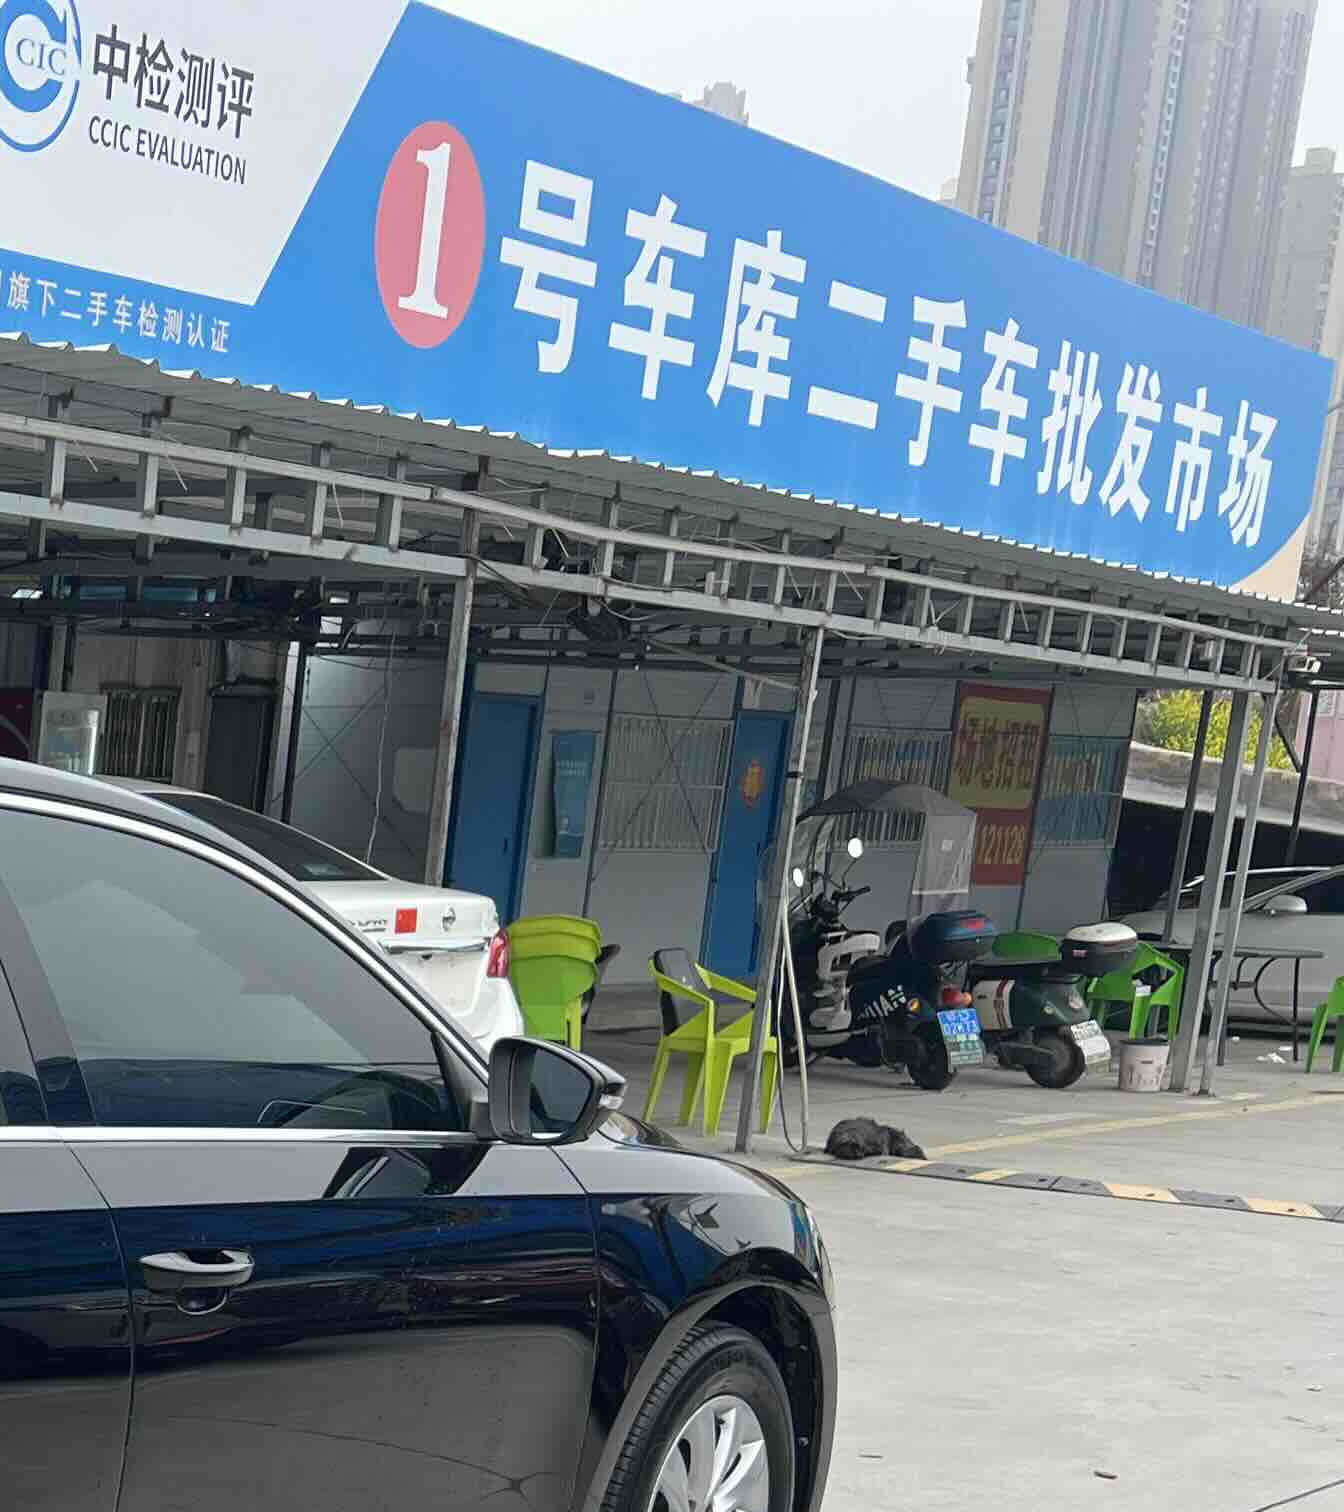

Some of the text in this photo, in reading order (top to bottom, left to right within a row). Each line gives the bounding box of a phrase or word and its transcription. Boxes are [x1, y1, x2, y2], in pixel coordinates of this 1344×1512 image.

[92, 24, 255, 139] 中检测评
[88, 115, 247, 185] CCIC EVALUATION
